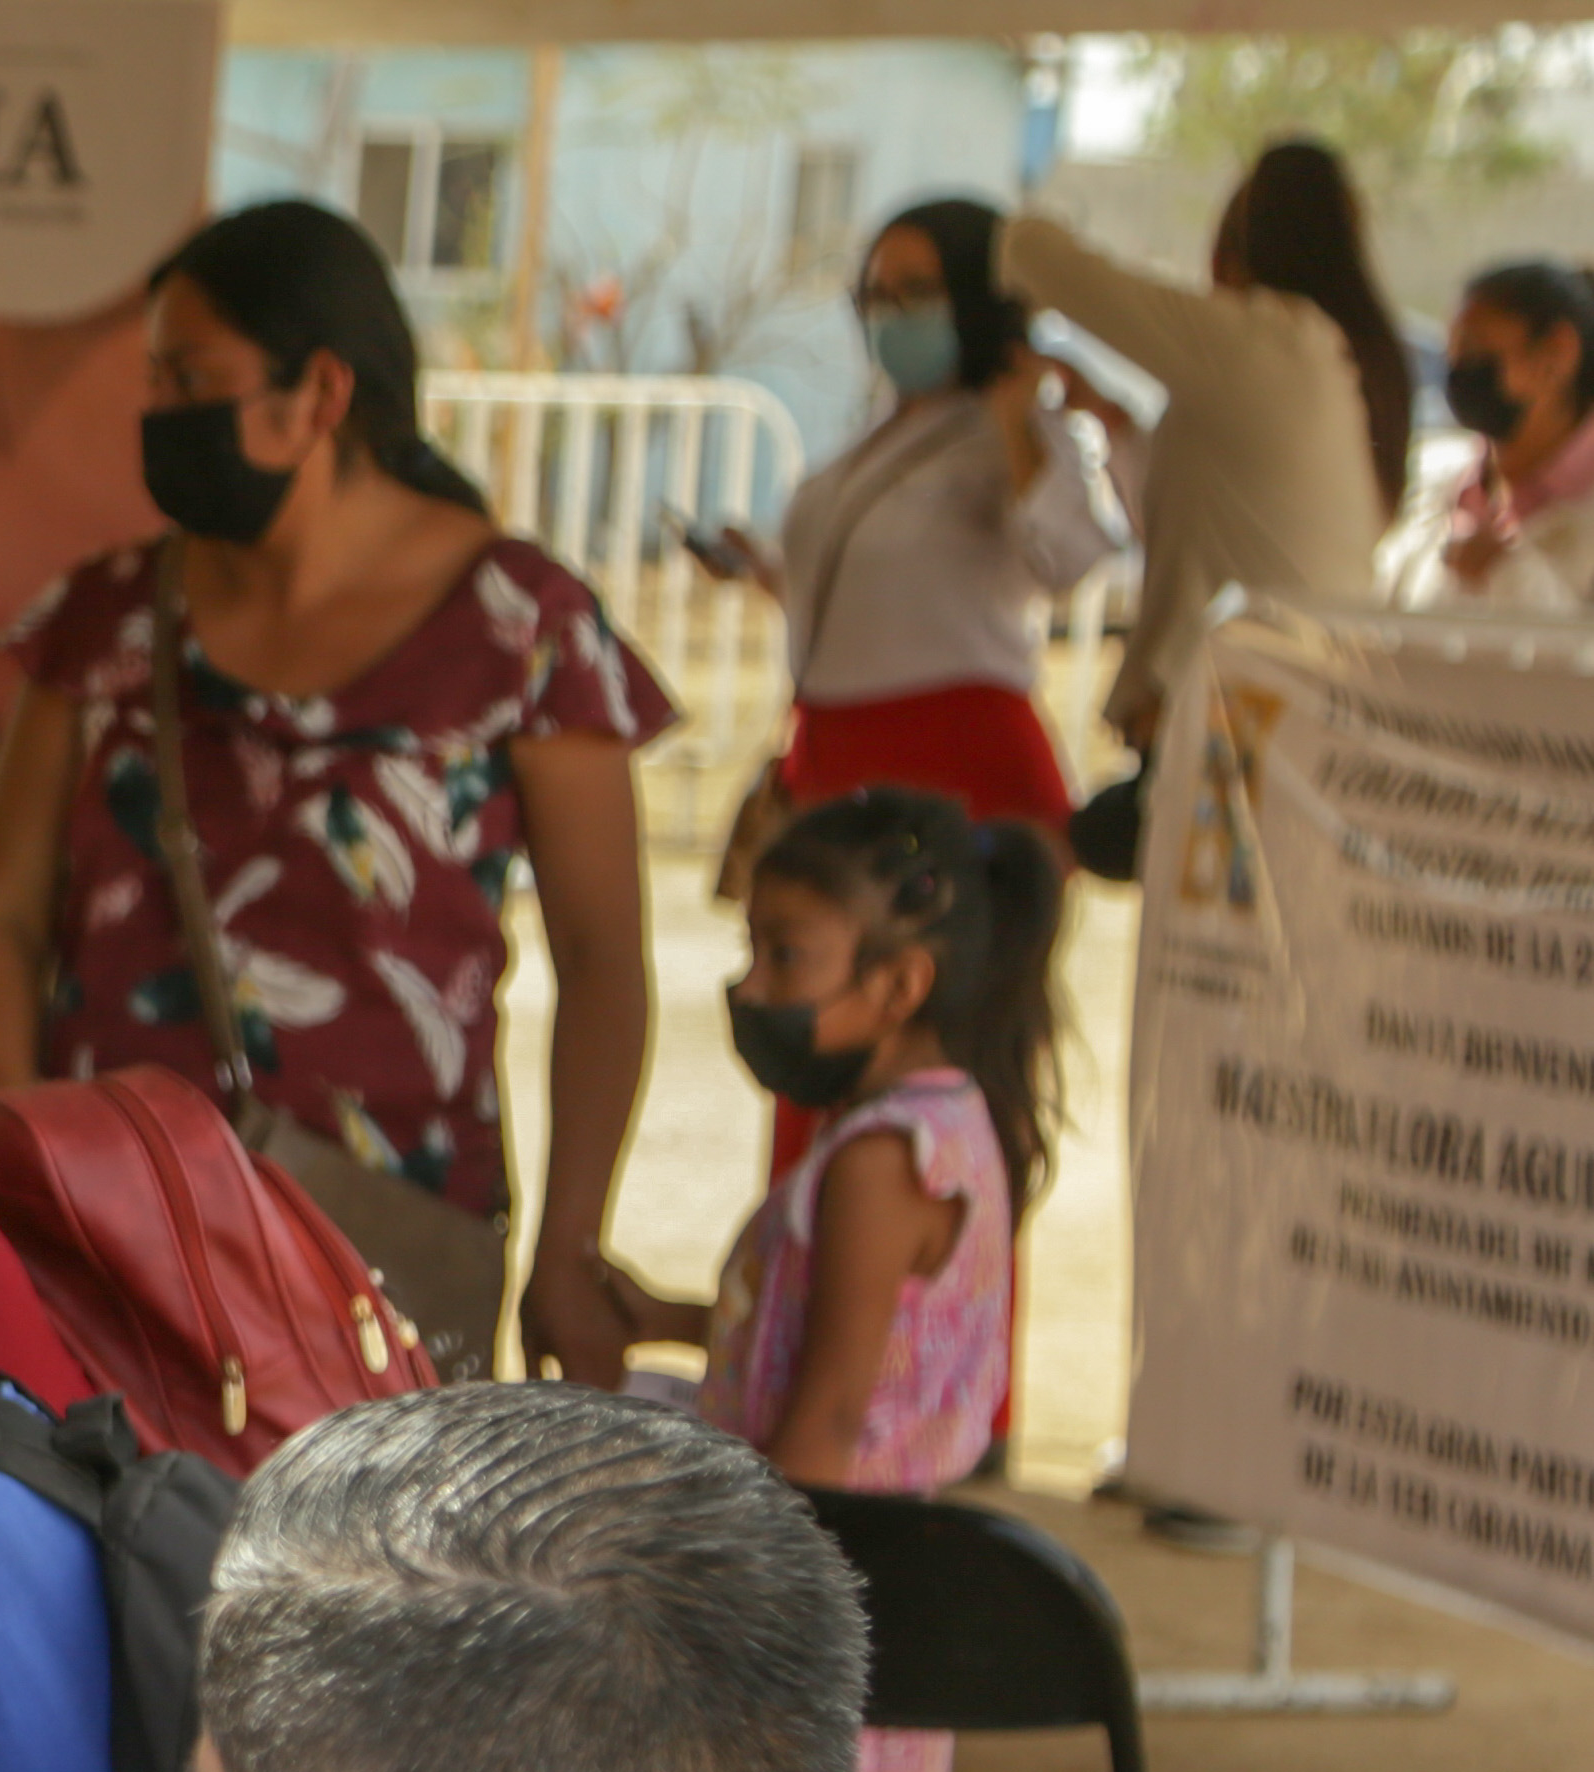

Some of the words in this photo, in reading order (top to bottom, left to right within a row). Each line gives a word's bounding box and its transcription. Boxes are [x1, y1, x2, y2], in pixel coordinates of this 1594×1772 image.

[1293, 1371, 1351, 1428] POR
[1426, 1416, 1499, 1478] GRAN
[1446, 1492, 1593, 1582] CARAVANA
